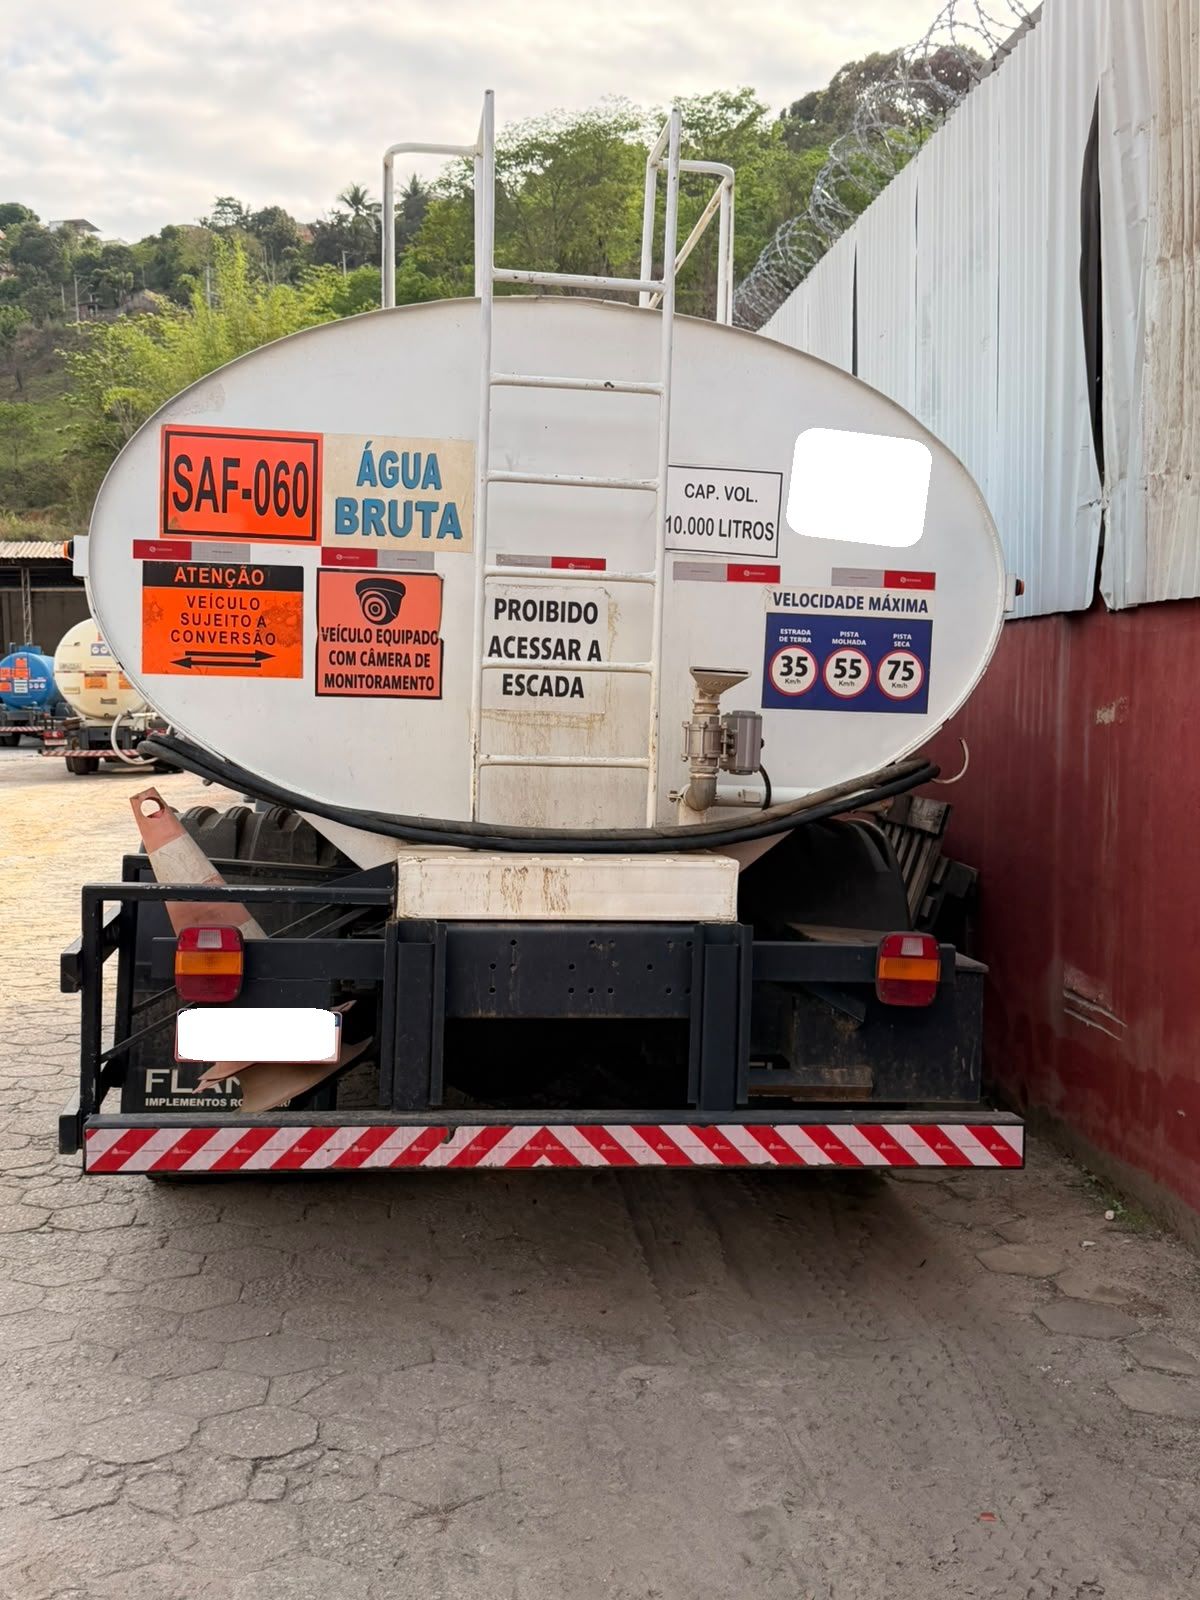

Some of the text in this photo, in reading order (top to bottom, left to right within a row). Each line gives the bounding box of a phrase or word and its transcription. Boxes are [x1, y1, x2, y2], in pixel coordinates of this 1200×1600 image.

[356, 440, 442, 490] ÁGUA
[172, 453, 310, 519] SAF-060
[684, 483, 758, 503] CAP. VOL.
[335, 496, 463, 540] BRUTA
[665, 515, 774, 541] 10.000 LITROS
[174, 566, 264, 588] ATENÇÃO
[186, 593, 260, 610] VEÍCULO
[494, 598, 598, 624] PROIBIDO
[772, 592, 929, 614] VELOCIDADE MÁXIMA
[180, 612, 267, 628] SUJEITO A
[170, 630, 276, 646] CONVERSÃO
[321, 624, 439, 647] VEÍCULO EQUIPADO
[328, 648, 431, 668] COM CÂMERA DE
[488, 635, 602, 662] ACESSAR A
[779, 655, 808, 677] 35
[833, 658, 862, 680] 55
[887, 660, 915, 682] 75
[324, 673, 434, 691] MONITORAMENTO
[502, 674, 584, 698] ESCADA
[145, 1098, 228, 1107] IMPLEMENTOS
